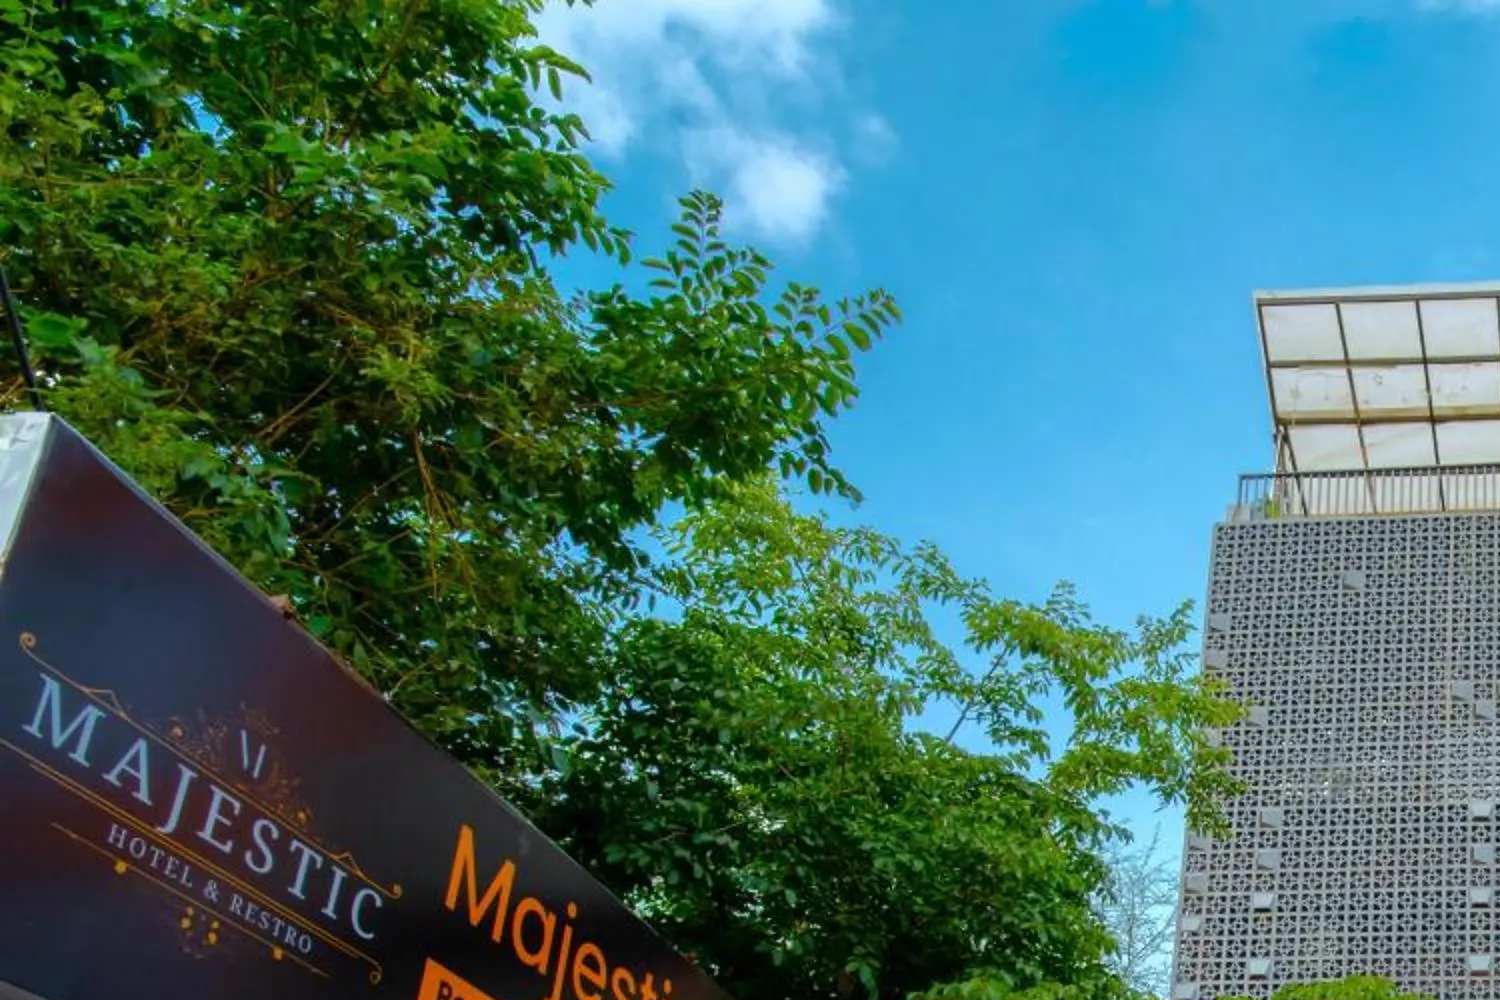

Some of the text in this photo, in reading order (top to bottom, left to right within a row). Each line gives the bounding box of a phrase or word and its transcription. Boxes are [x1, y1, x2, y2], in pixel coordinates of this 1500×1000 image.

[22, 673, 383, 939] MAJESTIC
[108, 824, 312, 954] HOTEL & RESTRO
